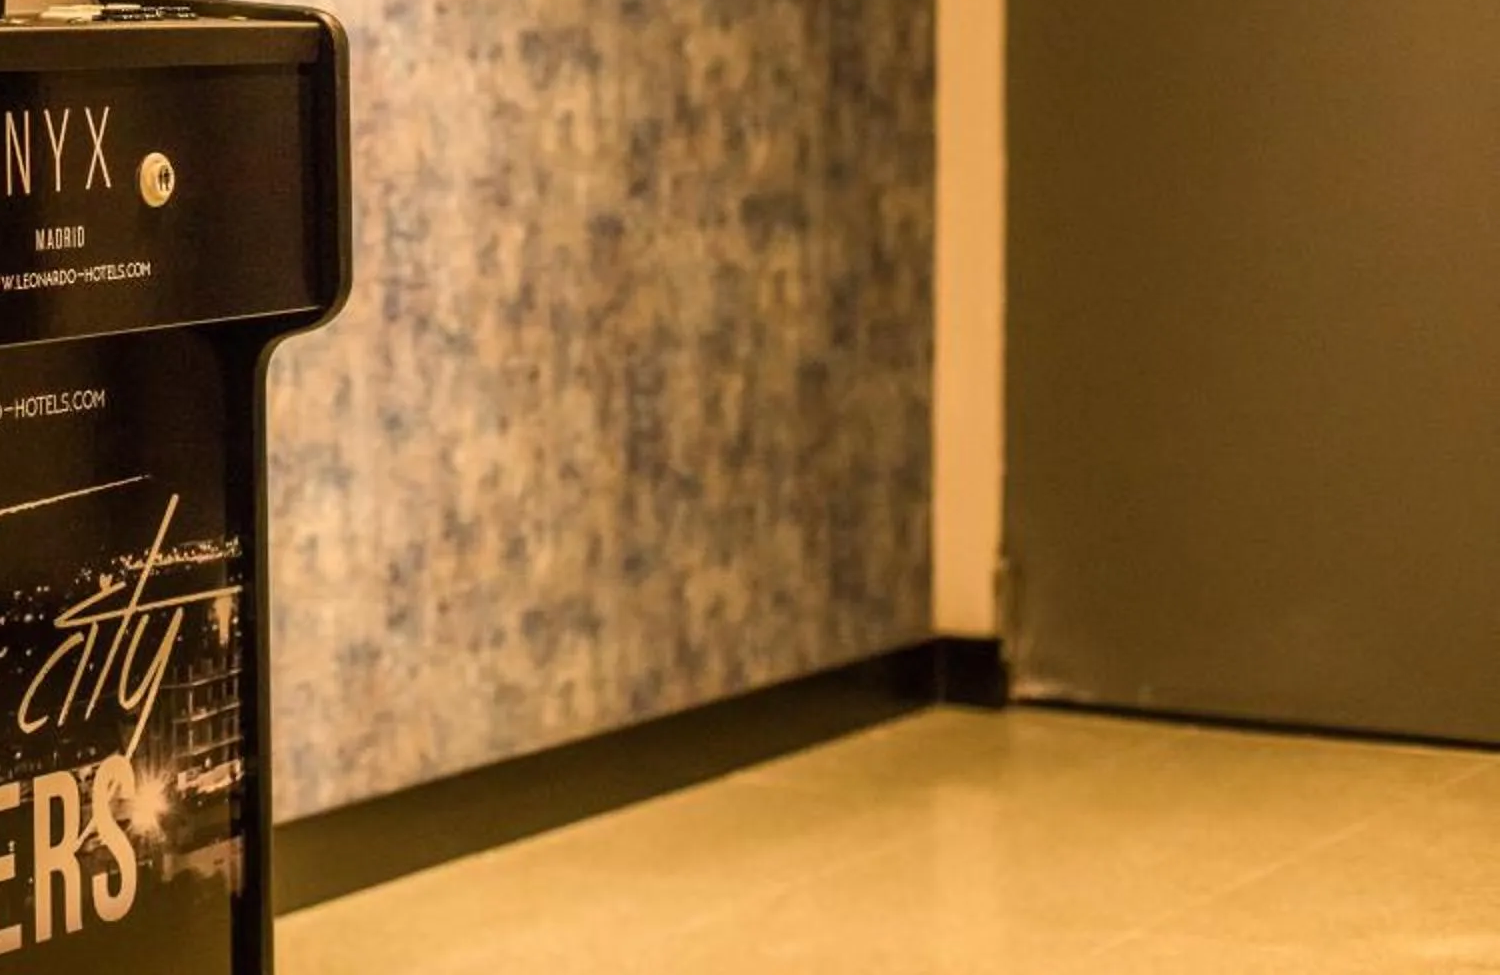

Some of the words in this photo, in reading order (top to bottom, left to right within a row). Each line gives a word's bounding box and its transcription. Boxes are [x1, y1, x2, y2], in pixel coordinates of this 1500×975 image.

[4, 106, 112, 197] NYX
[35, 226, 85, 251] MADRID
[17, 493, 242, 759] city
